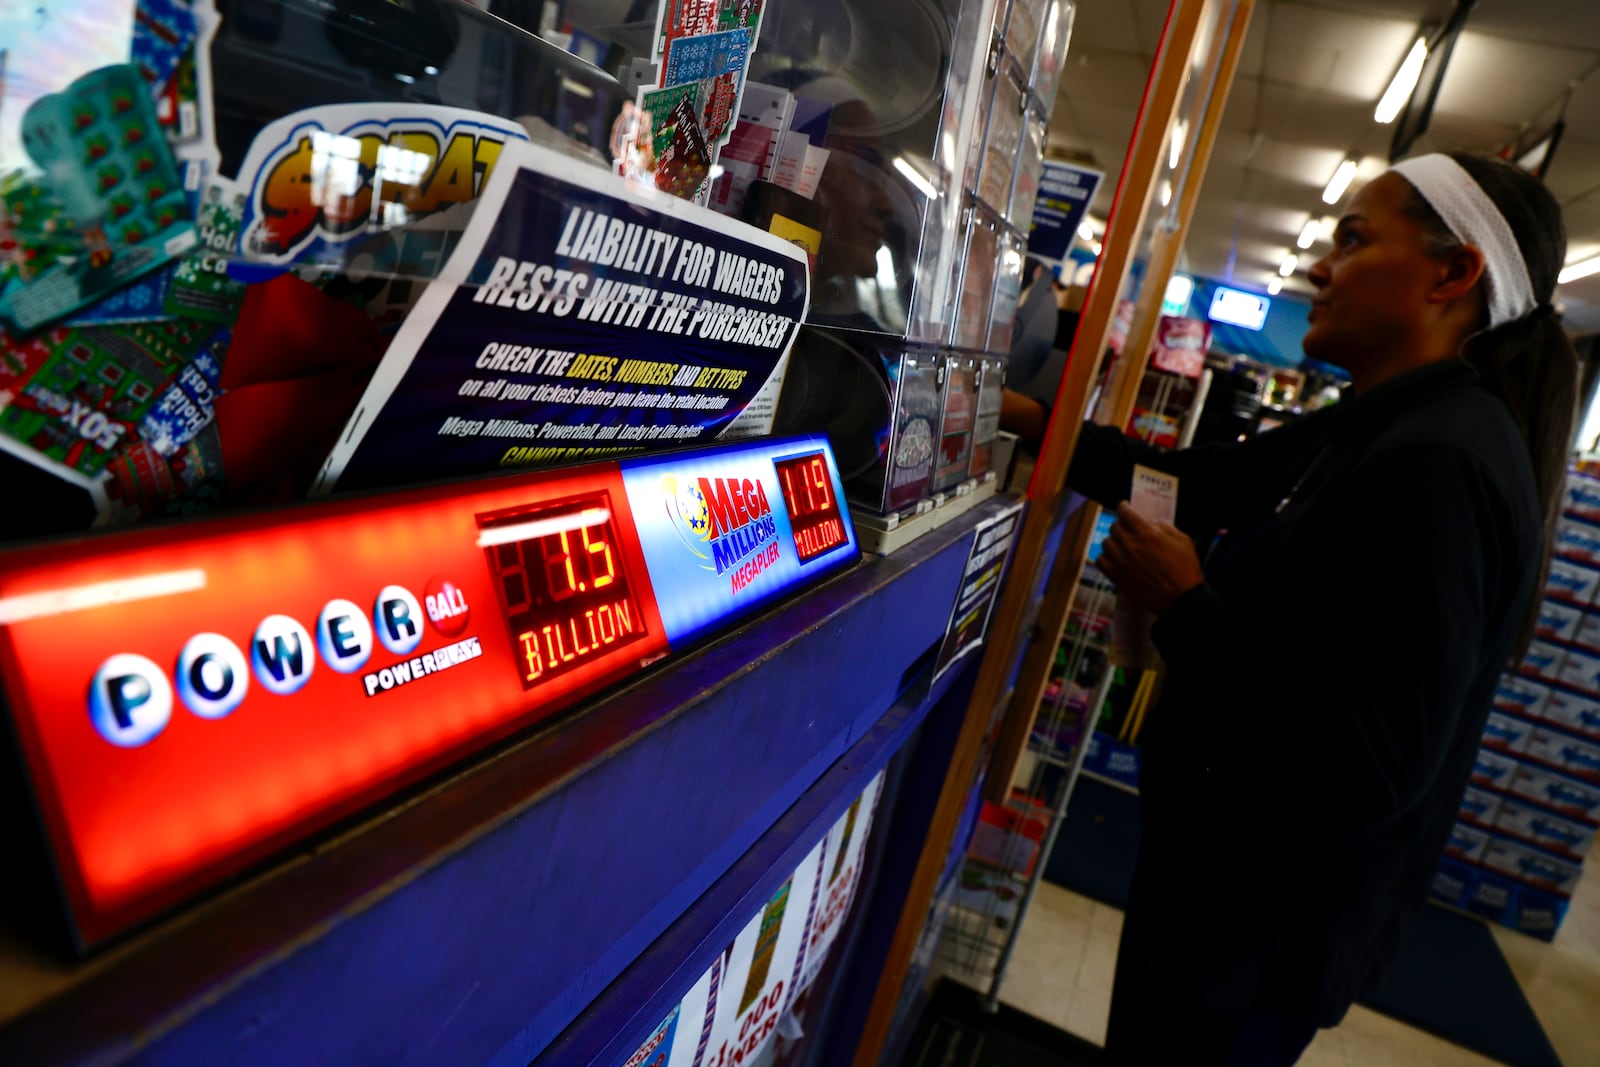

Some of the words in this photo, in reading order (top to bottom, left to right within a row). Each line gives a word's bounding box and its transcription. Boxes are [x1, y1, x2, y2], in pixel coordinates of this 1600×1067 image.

[555, 207, 679, 278] LIABILITY
[672, 239, 715, 288] FOR
[713, 250, 784, 304] WAGERS
[473, 256, 588, 317] RESTS
[577, 277, 658, 328] WITH
[648, 291, 699, 334] THE
[686, 300, 793, 349] PURCHASER
[179, 364, 214, 405] Cash
[458, 379, 484, 396] on
[479, 378, 507, 398] all
[498, 382, 537, 401] your
[532, 384, 579, 404] tickets
[574, 387, 616, 407] before
[611, 392, 638, 408] you
[630, 391, 663, 408] leave
[656, 393, 676, 409] the
[671, 394, 702, 409] retail
[693, 394, 729, 410] location
[475, 342, 545, 374] CHECK
[537, 350, 576, 377] THE
[565, 353, 618, 383] DATES,
[613, 359, 679, 386] NUMBERS
[670, 364, 701, 387] AND
[693, 367, 722, 388] BET
[713, 369, 748, 390] TYPES
[438, 417, 484, 437] Mega
[480, 419, 539, 440] Millions,
[536, 422, 600, 441] Powerball,
[595, 423, 622, 439] and
[617, 424, 650, 441] Lucky
[643, 425, 665, 440] For
[657, 425, 677, 440] Life
[673, 425, 704, 439] tickets
[498, 446, 566, 467] CANNOT
[697, 477, 771, 543] MEGA
[785, 459, 831, 517] 119
[559, 508, 615, 593] 1.5
[711, 515, 776, 577] MILLIONS
[794, 518, 842, 557] MILLION
[730, 541, 781, 597] MEGAPLIER
[519, 599, 633, 682] BILLION
